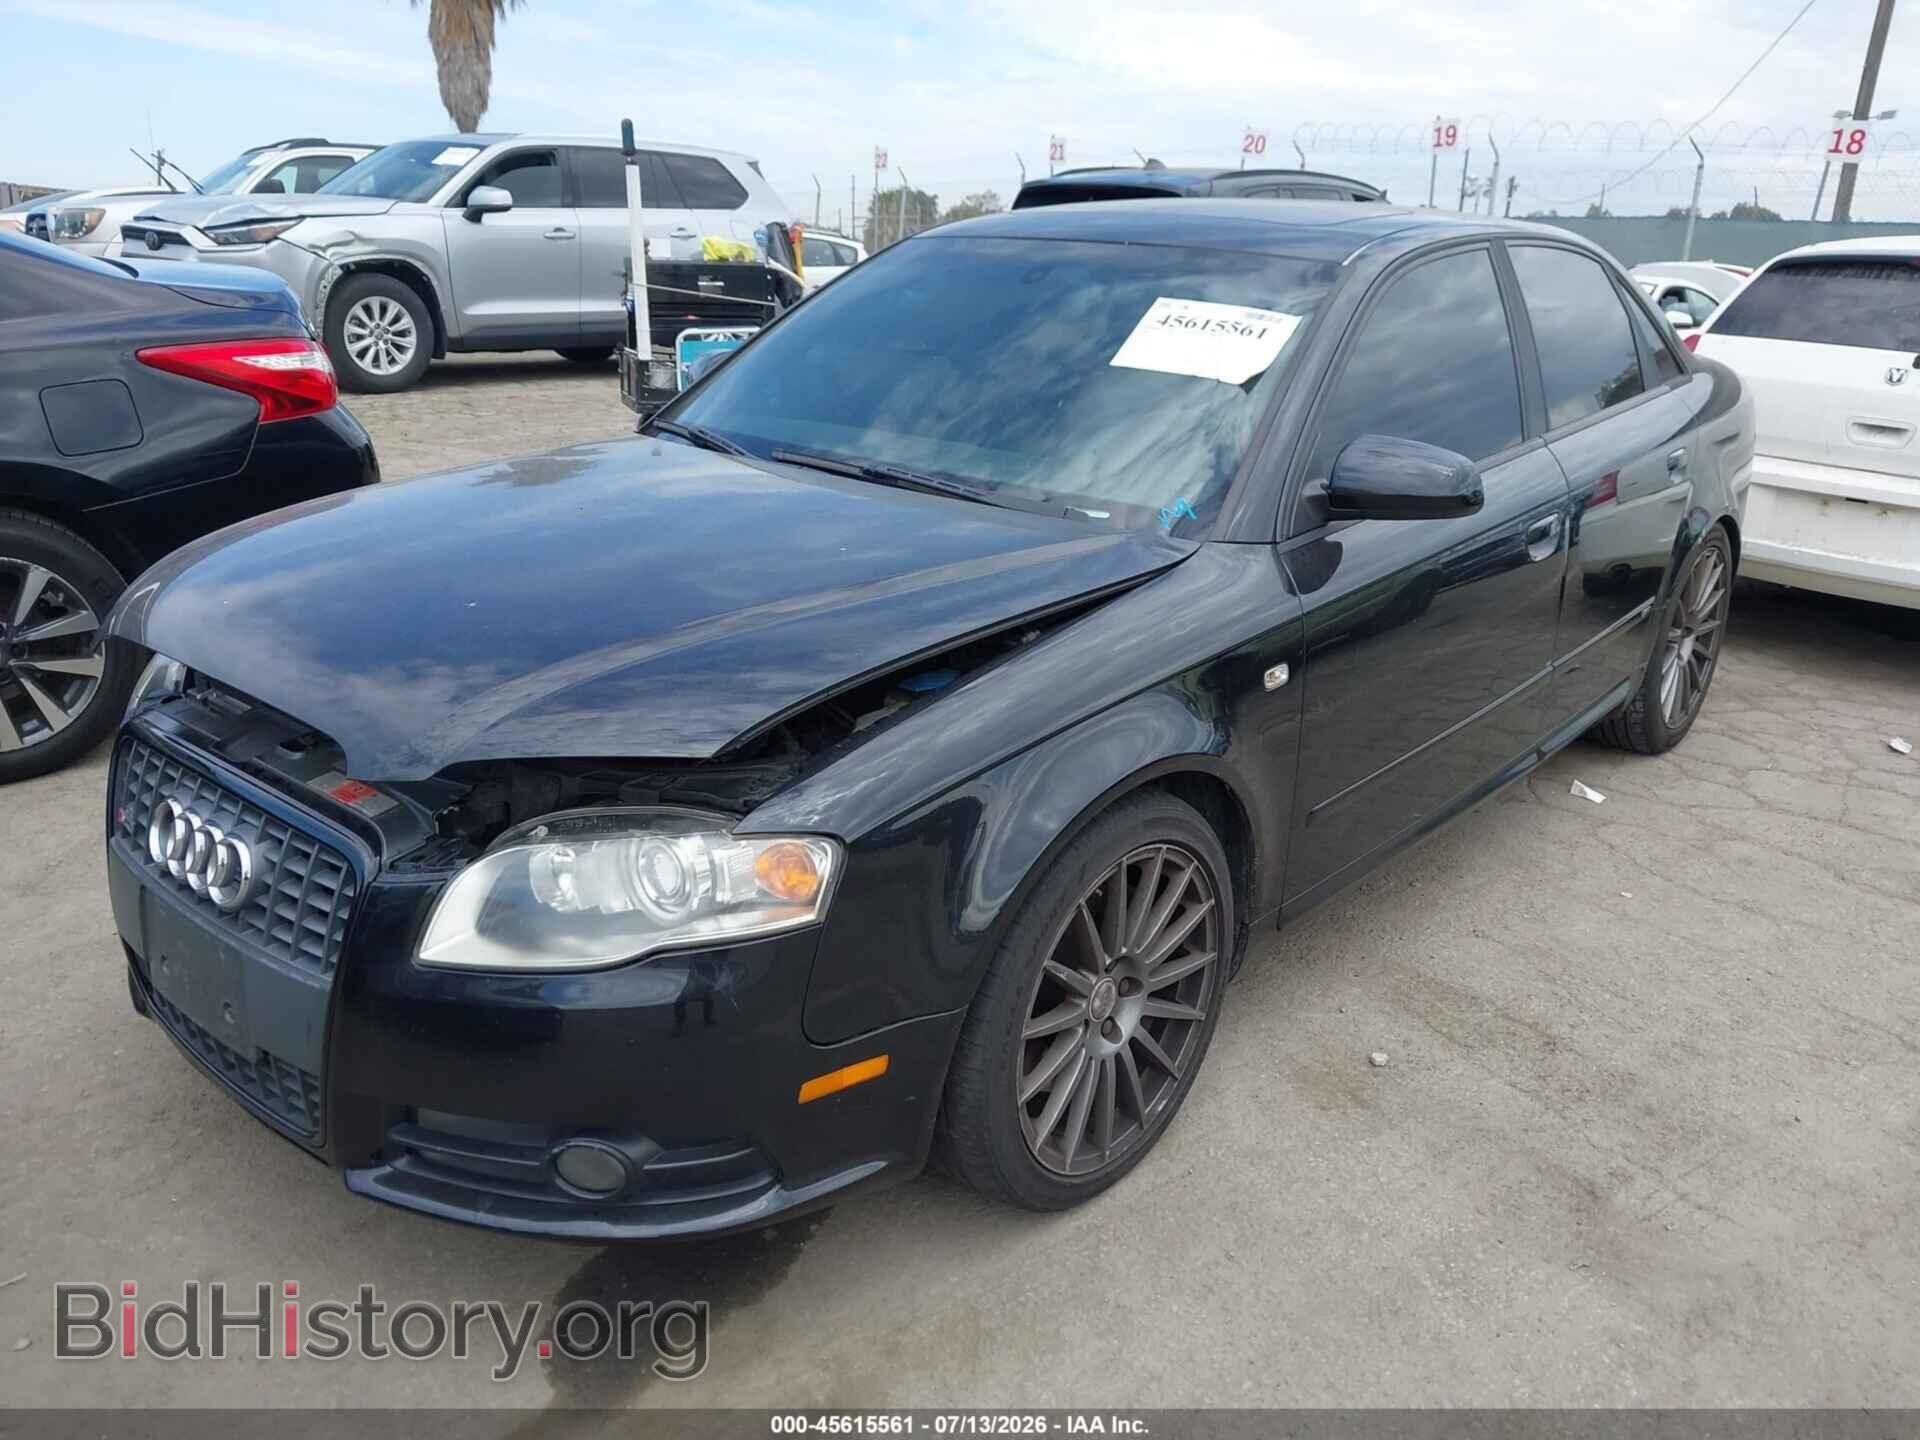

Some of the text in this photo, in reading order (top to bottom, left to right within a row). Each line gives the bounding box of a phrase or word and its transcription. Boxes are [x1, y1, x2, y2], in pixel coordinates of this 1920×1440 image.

[1242, 134, 1266, 154] 20
[1432, 124, 1457, 147] 19
[1827, 128, 1866, 155] 18
[1050, 143, 1064, 160] 21
[1156, 313, 1269, 340] 45615561
